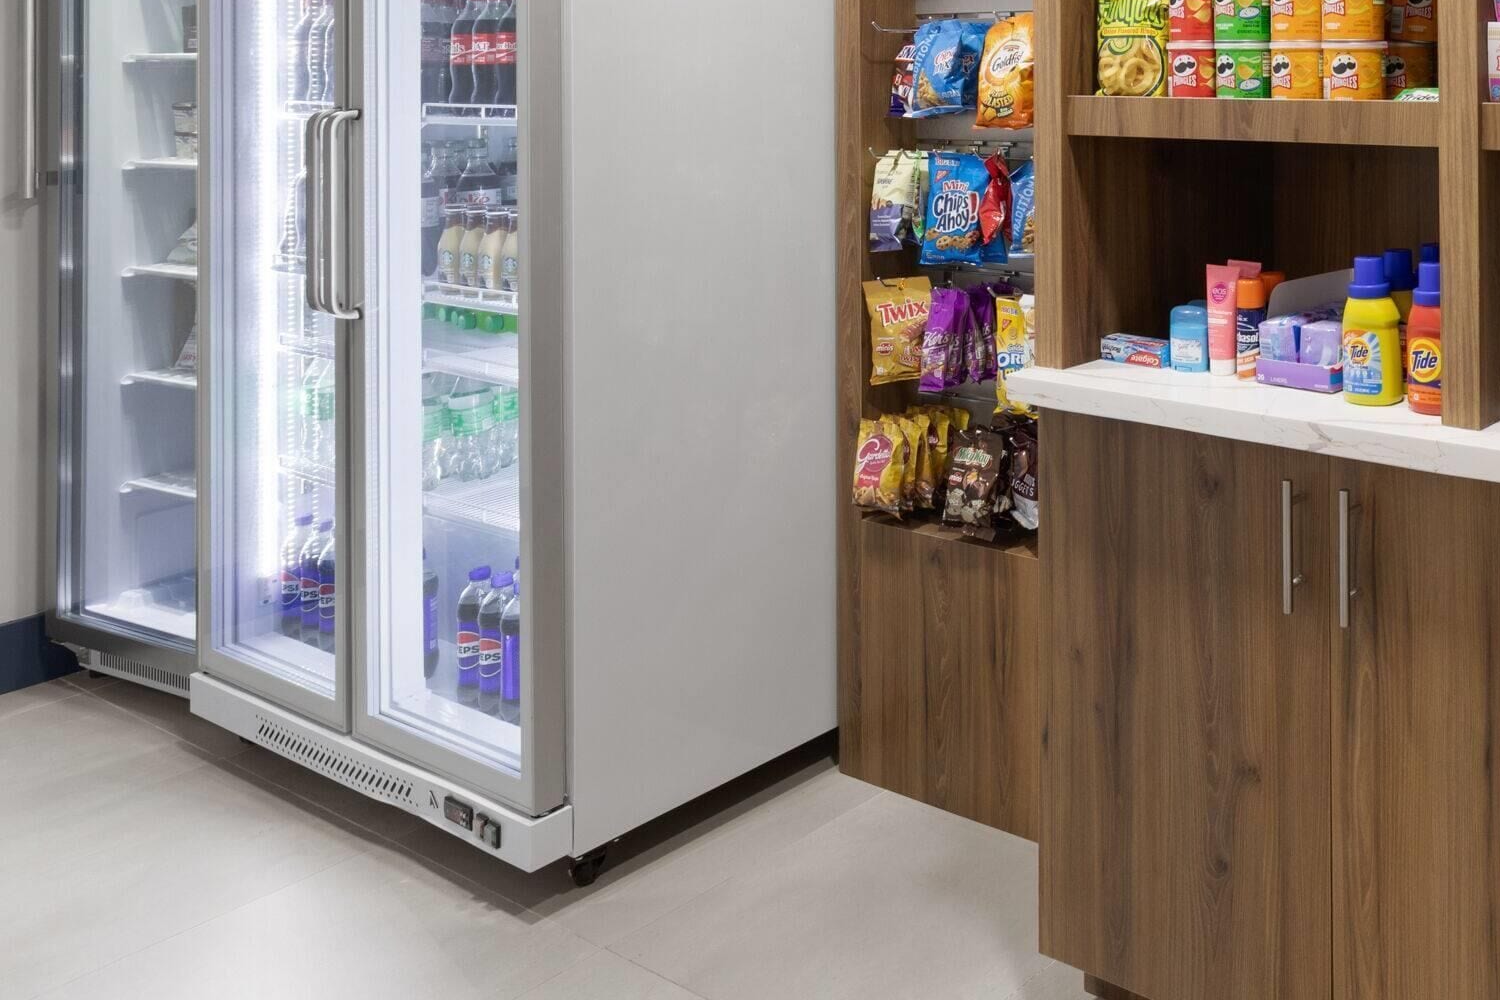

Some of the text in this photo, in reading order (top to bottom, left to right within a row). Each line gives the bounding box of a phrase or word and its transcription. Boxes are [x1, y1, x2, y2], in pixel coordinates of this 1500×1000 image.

[1406, 7, 1431, 18] PRINGLES
[992, 51, 1023, 71] Goldfis
[1173, 75, 1196, 86] PRINGLES
[1331, 75, 1357, 89] PRINGLES
[943, 182, 968, 191] Mini
[933, 194, 968, 215] Chips
[1013, 177, 1033, 236] TRADITION
[878, 301, 929, 326] Twix
[1350, 345, 1368, 359] Tide
[998, 353, 1024, 367] ORE
[1130, 355, 1160, 366] Colgate
[1412, 351, 1438, 372] Tide
[1011, 479, 1034, 496] UGGETS
[458, 645, 479, 654] EPS
[480, 653, 501, 662] EPS
